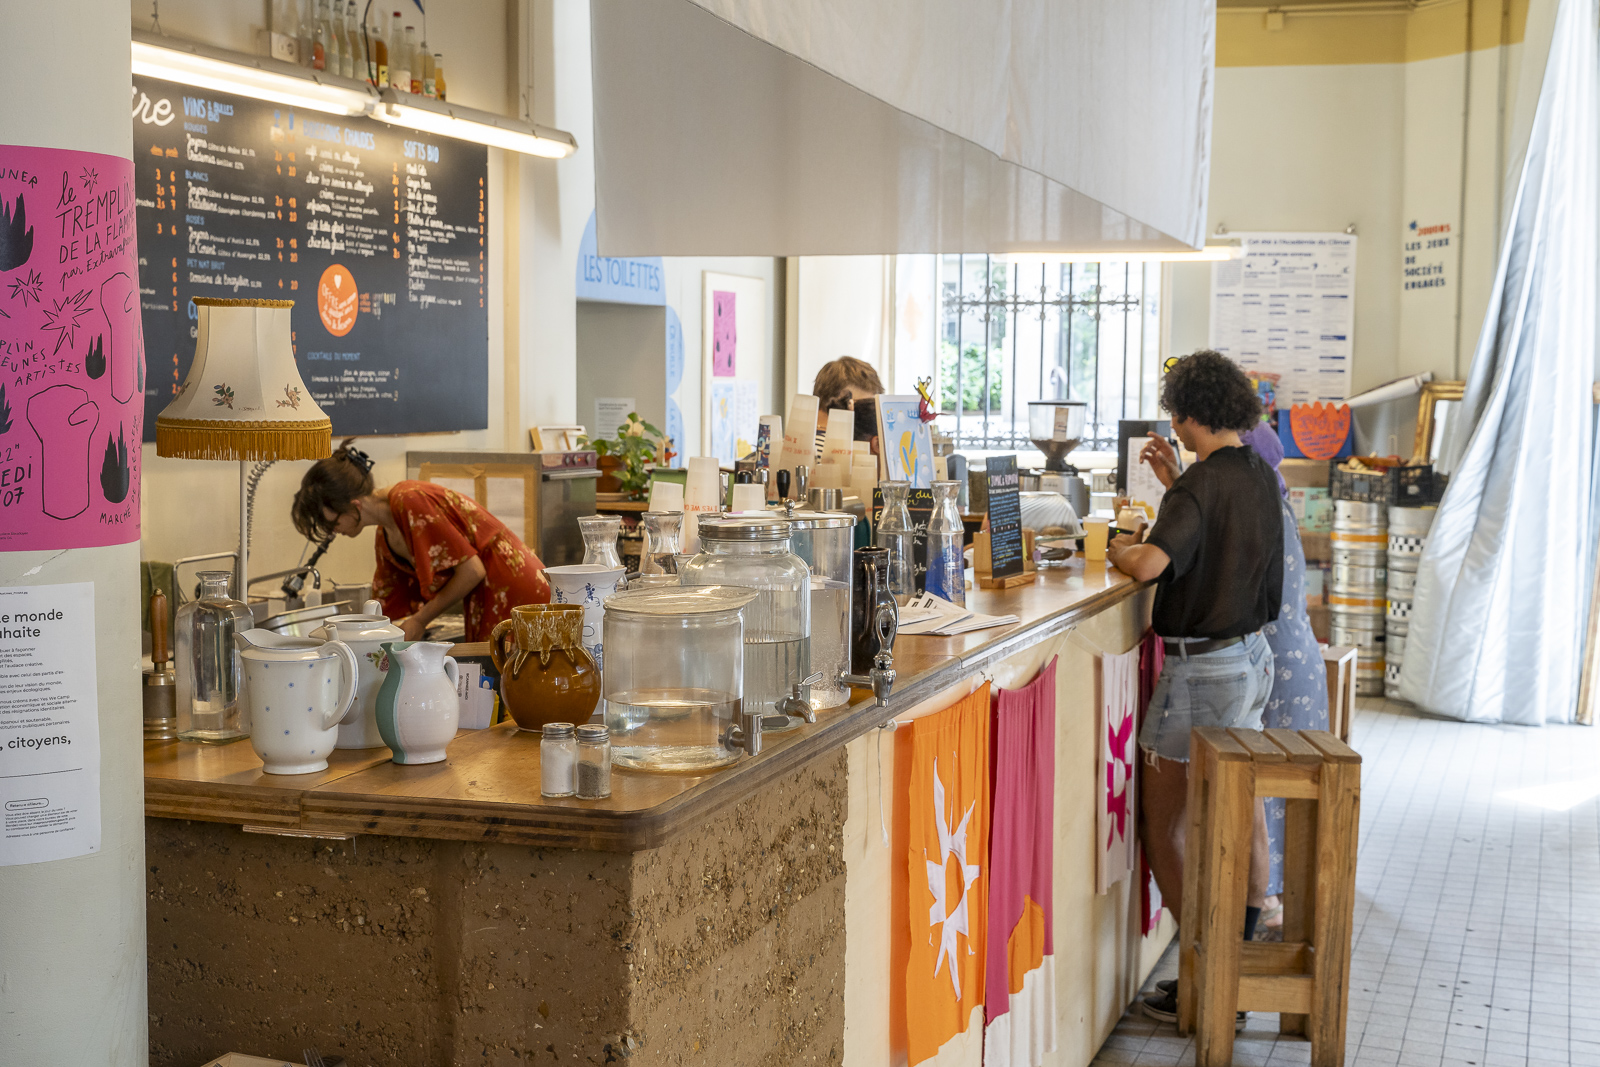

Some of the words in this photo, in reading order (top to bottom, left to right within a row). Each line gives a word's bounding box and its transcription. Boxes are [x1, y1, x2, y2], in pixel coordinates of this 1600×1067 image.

[132, 86, 175, 126] re
[183, 96, 206, 118] VINS
[344, 128, 374, 150] CHAUDES
[404, 140, 426, 160] SOFTS
[427, 144, 439, 163] BIO
[156, 169, 161, 180] 3
[170, 171, 175, 182] 6
[185, 170, 208, 182] BLANCS
[56, 171, 76, 209] le
[55, 182, 131, 238] TREMPLIN
[171, 199, 176, 210] 7
[157, 223, 162, 234] 3
[171, 225, 177, 236] 6
[60, 240, 79, 264] DE
[86, 232, 101, 254] LA
[1405, 241, 1421, 251] LES
[172, 257, 177, 268] 6
[187, 258, 197, 268] PET
[1405, 261, 1443, 276] SOCIÉTÉ
[60, 266, 83, 292] par
[172, 272, 178, 283] 6
[584, 254, 602, 282] LES
[605, 257, 660, 292] TOILETTES
[173, 286, 178, 297] 6
[173, 301, 178, 312] 5
[15, 609, 63, 622] monde
[8, 735, 71, 750] citoyens,
